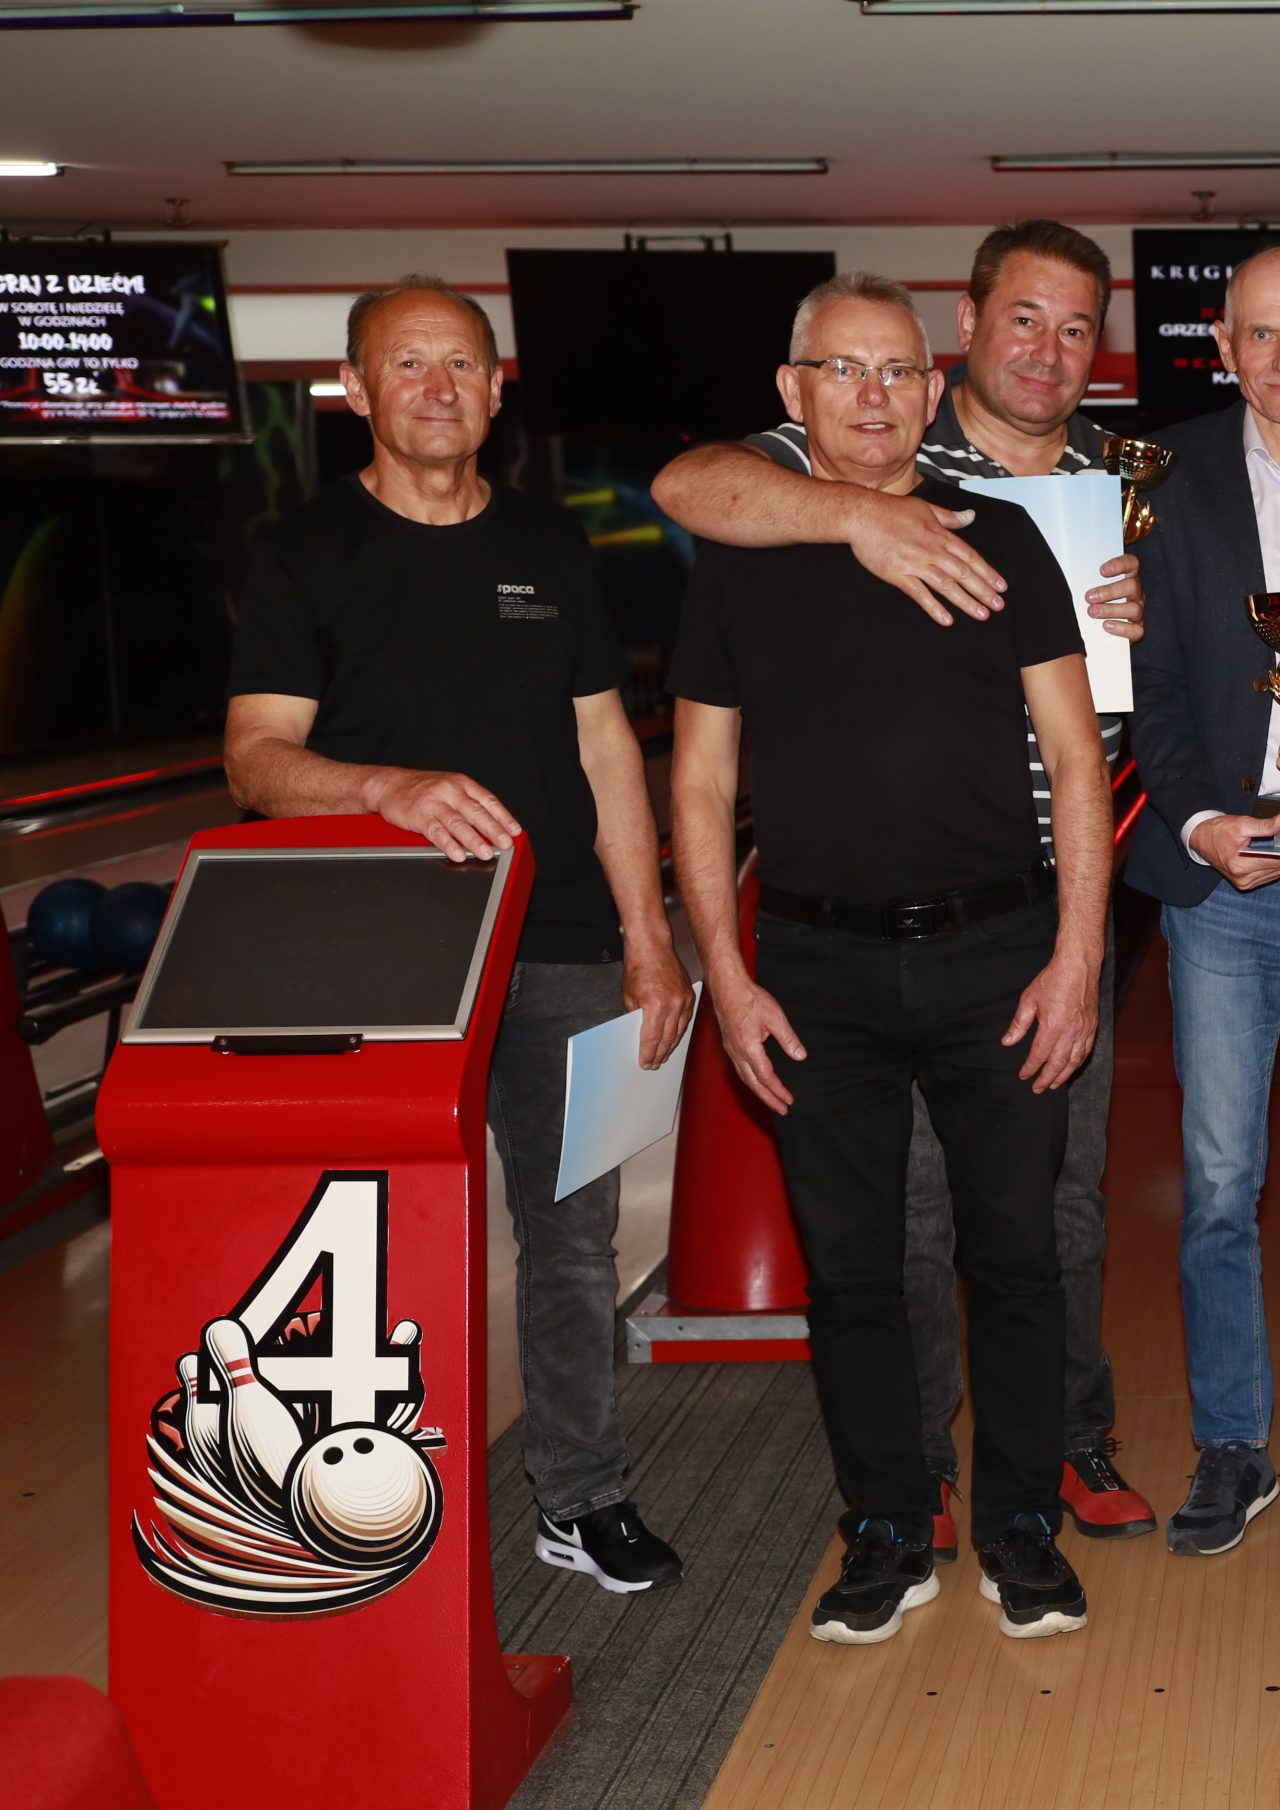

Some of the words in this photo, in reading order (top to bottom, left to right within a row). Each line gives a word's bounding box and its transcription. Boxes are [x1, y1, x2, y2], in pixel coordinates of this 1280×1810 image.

[45, 274, 64, 293] Z
[17, 316, 32, 327] W
[56, 357, 80, 369] GRY
[82, 357, 100, 369] TO
[101, 357, 139, 369] TYLKO
[43, 372, 74, 394] 55
[197, 1170, 413, 1426] 4
